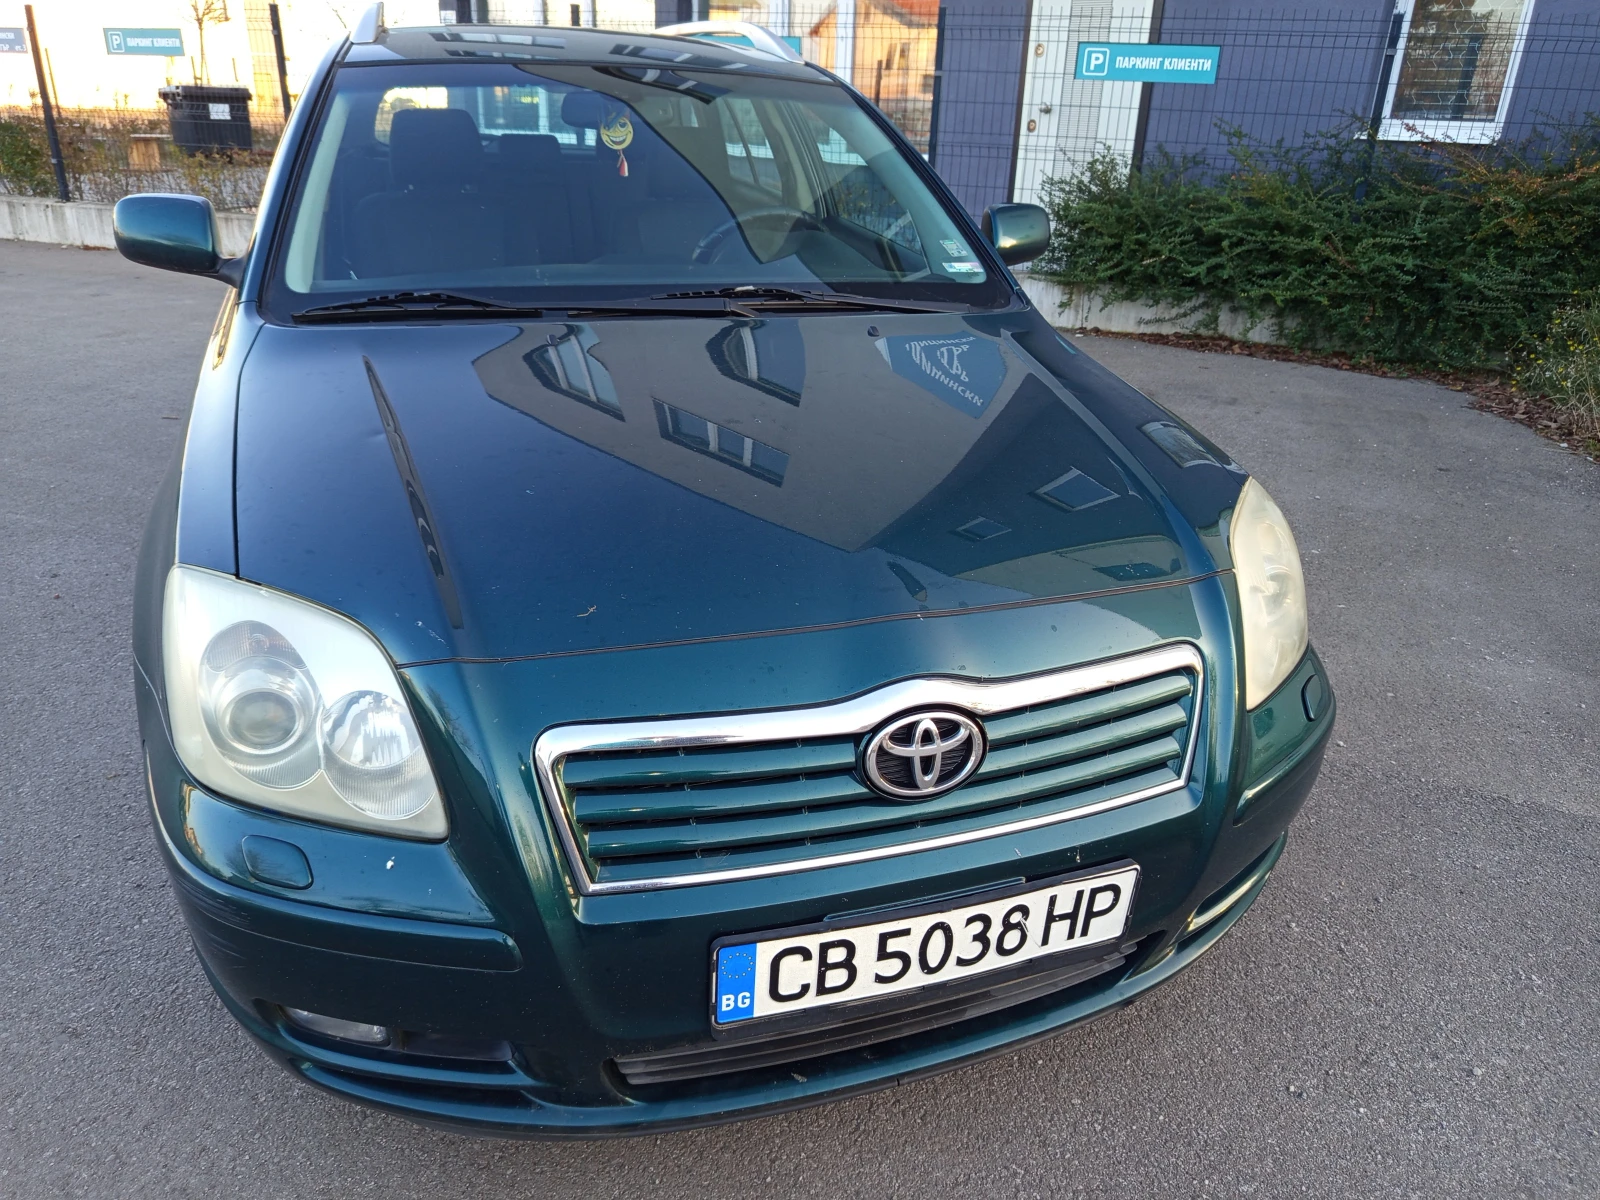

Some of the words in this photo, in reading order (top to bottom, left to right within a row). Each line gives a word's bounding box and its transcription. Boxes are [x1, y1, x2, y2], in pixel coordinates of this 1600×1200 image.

[126, 37, 153, 47] ПАРКИНГ
[153, 38, 181, 47] КЛИЕНТИ
[1089, 52, 1104, 71] P
[1115, 56, 1163, 69] ПАРКИНГ
[1163, 58, 1212, 71] КЛИЕНТИ
[768, 938, 858, 1003] CB
[874, 903, 1031, 984] 5038
[1040, 882, 1122, 948] HP
[721, 991, 751, 1012] BG
